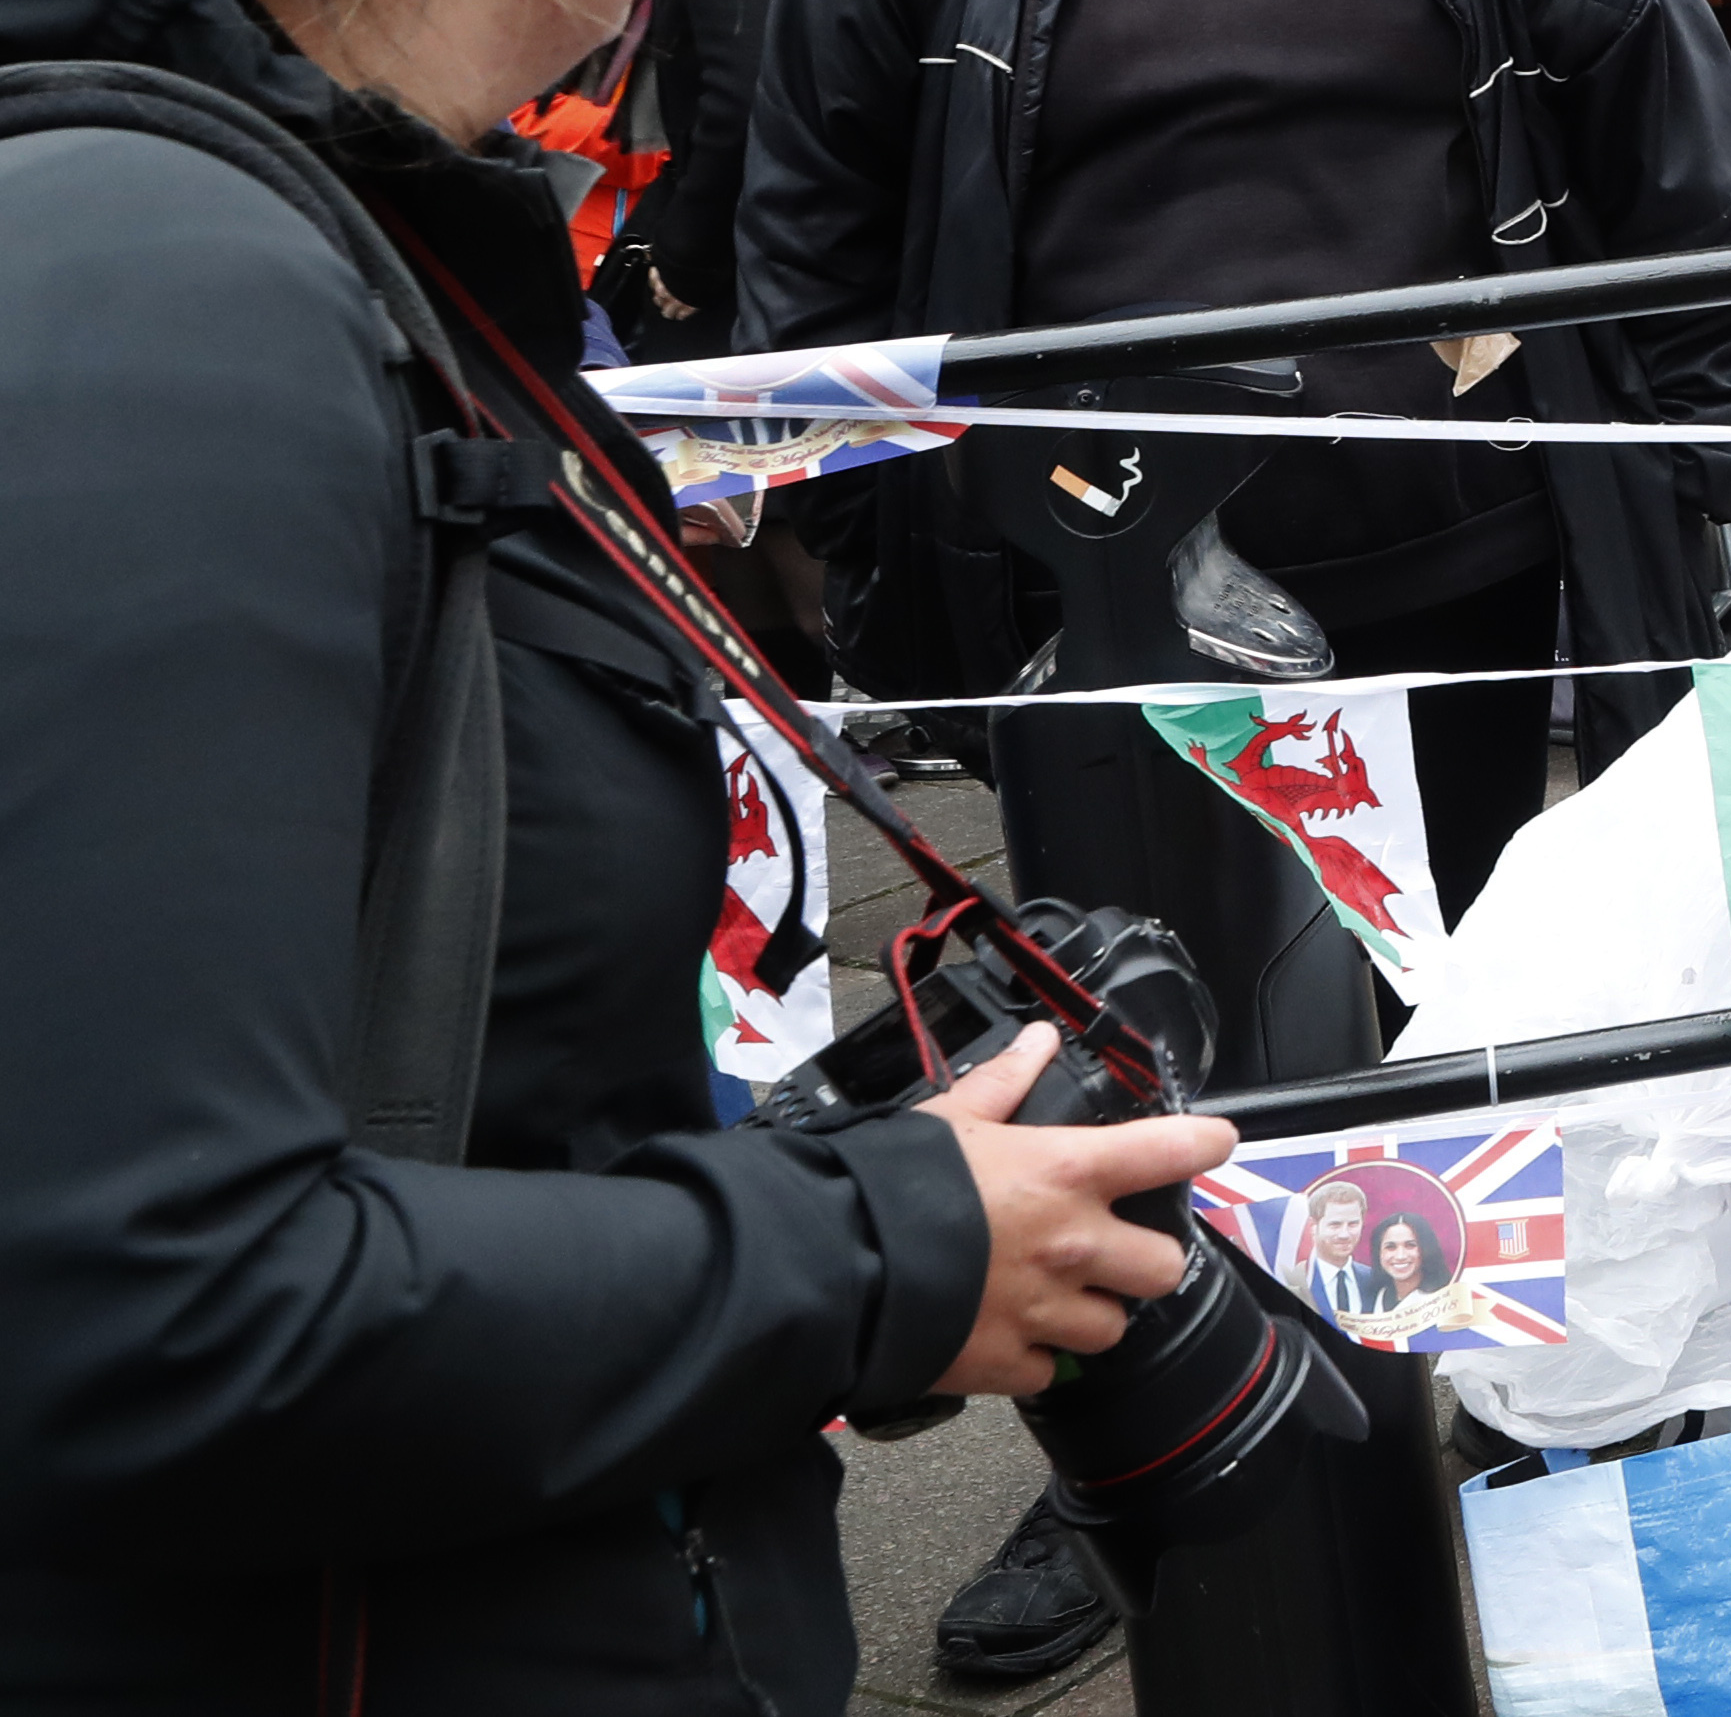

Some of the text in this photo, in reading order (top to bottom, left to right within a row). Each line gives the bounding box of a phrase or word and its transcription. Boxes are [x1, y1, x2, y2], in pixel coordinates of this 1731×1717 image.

[694, 450, 741, 470] Harry
[771, 443, 829, 467] Meghan
[1361, 1298, 1460, 1340] Meghan 2018
